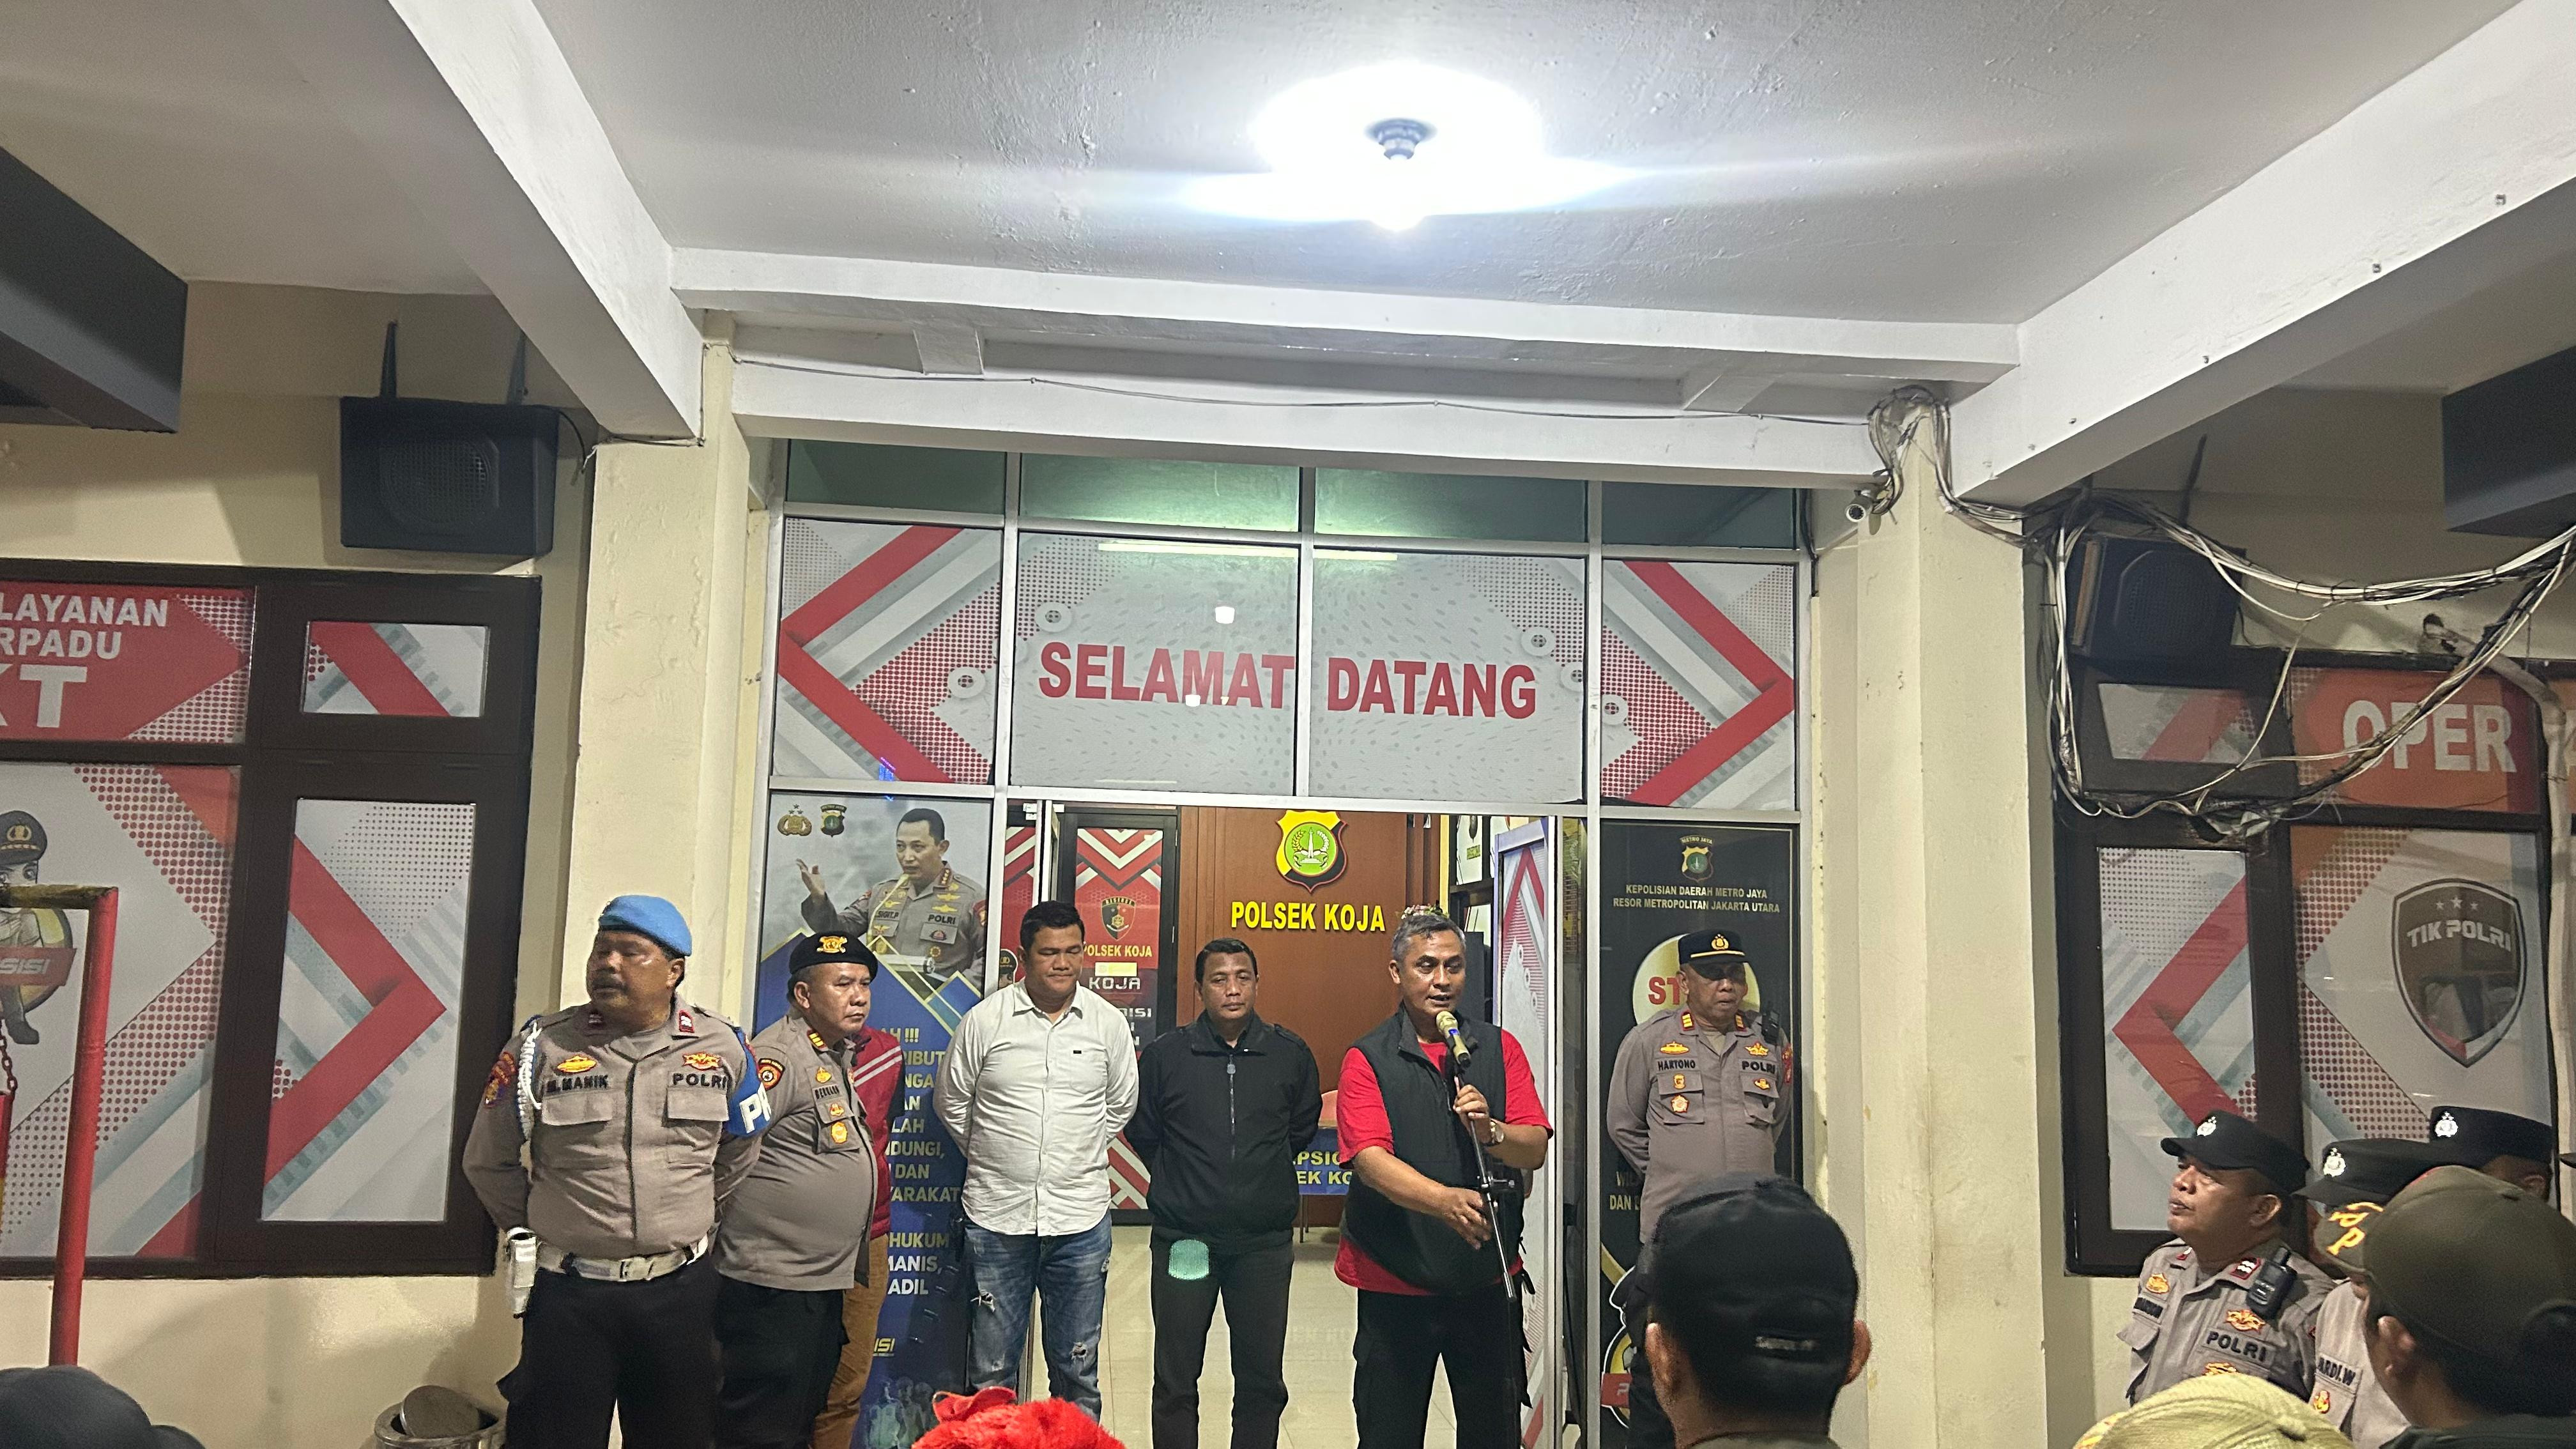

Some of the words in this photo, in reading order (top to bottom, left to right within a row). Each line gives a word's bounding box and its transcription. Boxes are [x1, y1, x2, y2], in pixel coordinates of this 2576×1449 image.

[1039, 641, 1294, 708] SELAMAT
[1328, 657, 1536, 719] DATANG
[0, 663, 88, 728] T
[2343, 700, 2517, 773] OPER
[1626, 884, 1677, 895] KEPOLISIAN
[1679, 886, 1713, 896] DAERAH
[1715, 887, 1744, 898] METRO
[1746, 889, 1768, 899] JAYA
[1613, 898, 1642, 907] RESOR
[1644, 899, 1708, 910] METROPOLITAN
[1711, 901, 1749, 912] JAKARTA
[1752, 903, 1780, 913] UTARA
[928, 914, 956, 924] POLRI
[1231, 901, 1316, 930] POLSEK
[1324, 904, 1385, 931] KOJA
[2407, 921, 2442, 947] TIK
[2446, 919, 2511, 952] POLRI
[1124, 946, 1153, 957] KOJA
[1089, 977, 1141, 990] KOJA
[1742, 1061, 1775, 1074] POLRI
[673, 1073, 730, 1087] POLRI
[895, 1163, 930, 1179] DAN
[890, 1186, 960, 1202] ARAKAT
[1609, 1194, 1632, 1211] DAN
[889, 1232, 949, 1248] HUKUM
[887, 1278, 929, 1295] ADIL
[2207, 1330, 2267, 1362] POLRI
